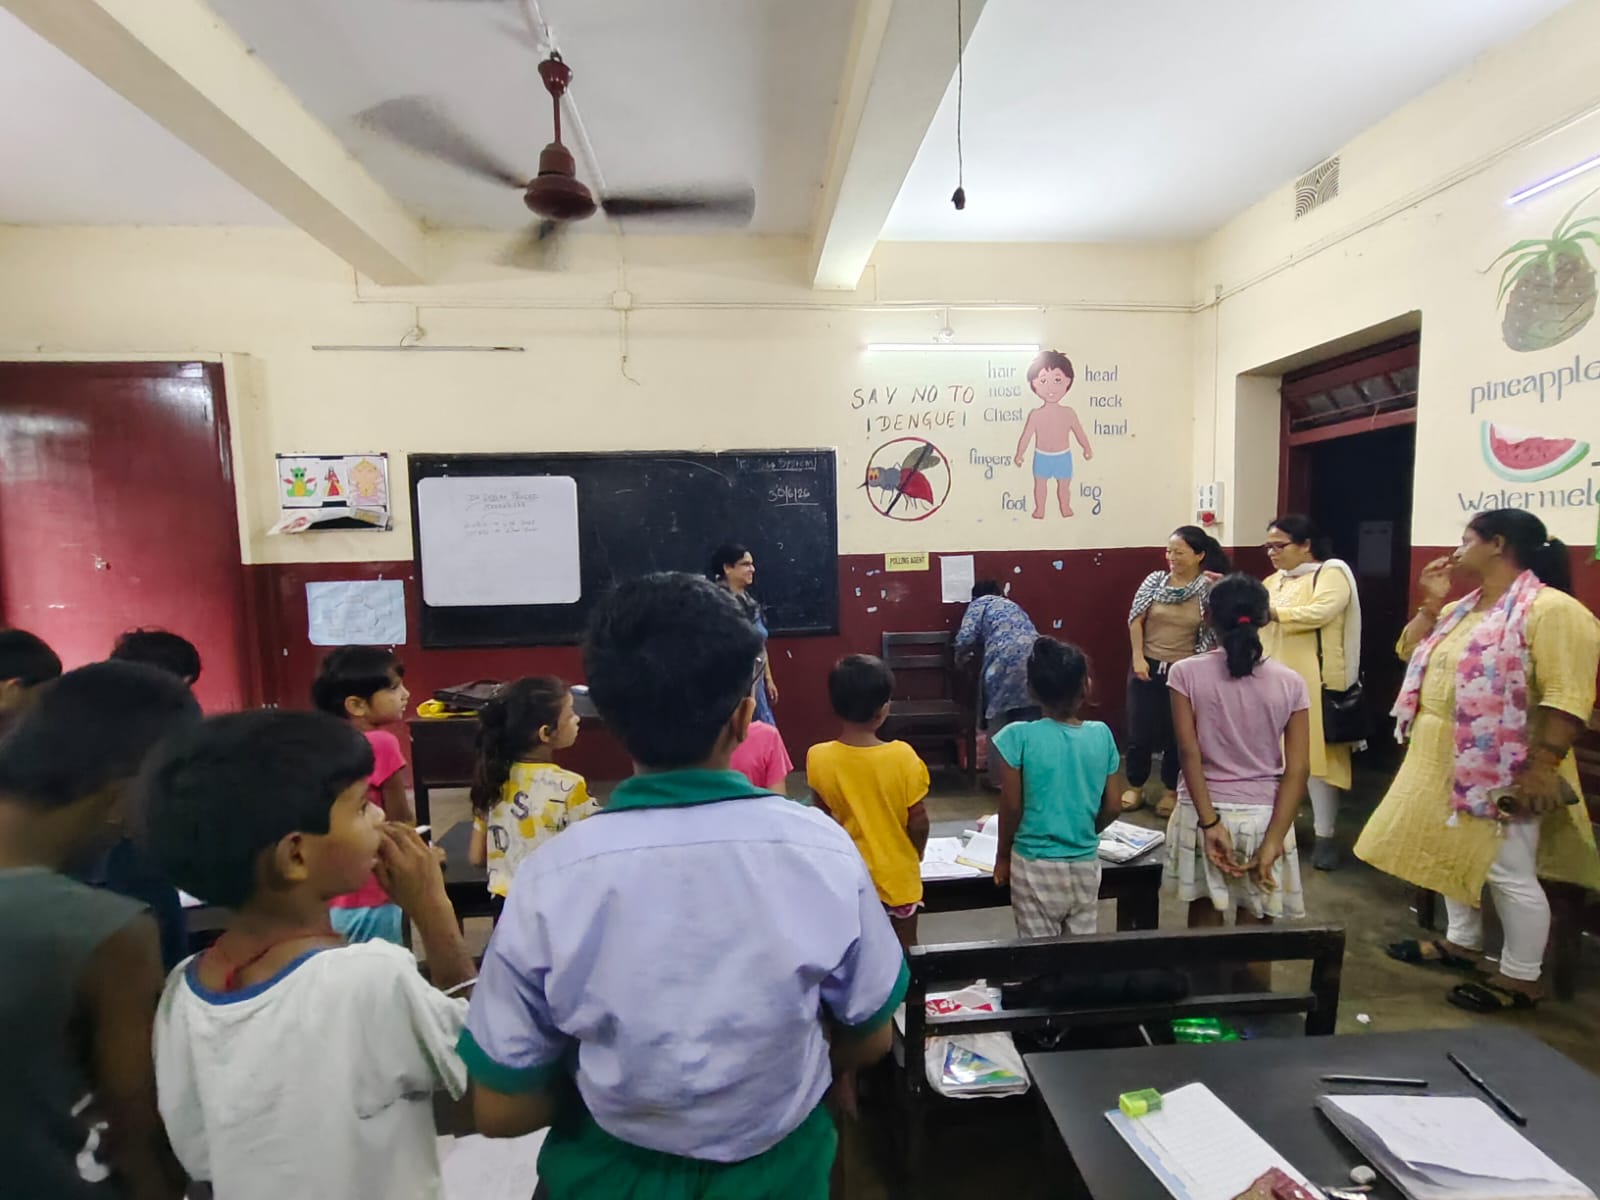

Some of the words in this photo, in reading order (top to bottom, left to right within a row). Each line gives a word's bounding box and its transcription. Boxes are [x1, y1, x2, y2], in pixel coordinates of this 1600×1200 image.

[988, 360, 1017, 379] hair
[1085, 364, 1118, 382] head
[851, 386, 898, 410] SAY
[911, 385, 938, 404] NO
[948, 385, 975, 404] TO
[989, 385, 1022, 398] nose
[1089, 395, 1122, 408] neck
[1094, 419, 1128, 436] hand
[969, 448, 1012, 480] fingers
[1002, 491, 1028, 512] foot
